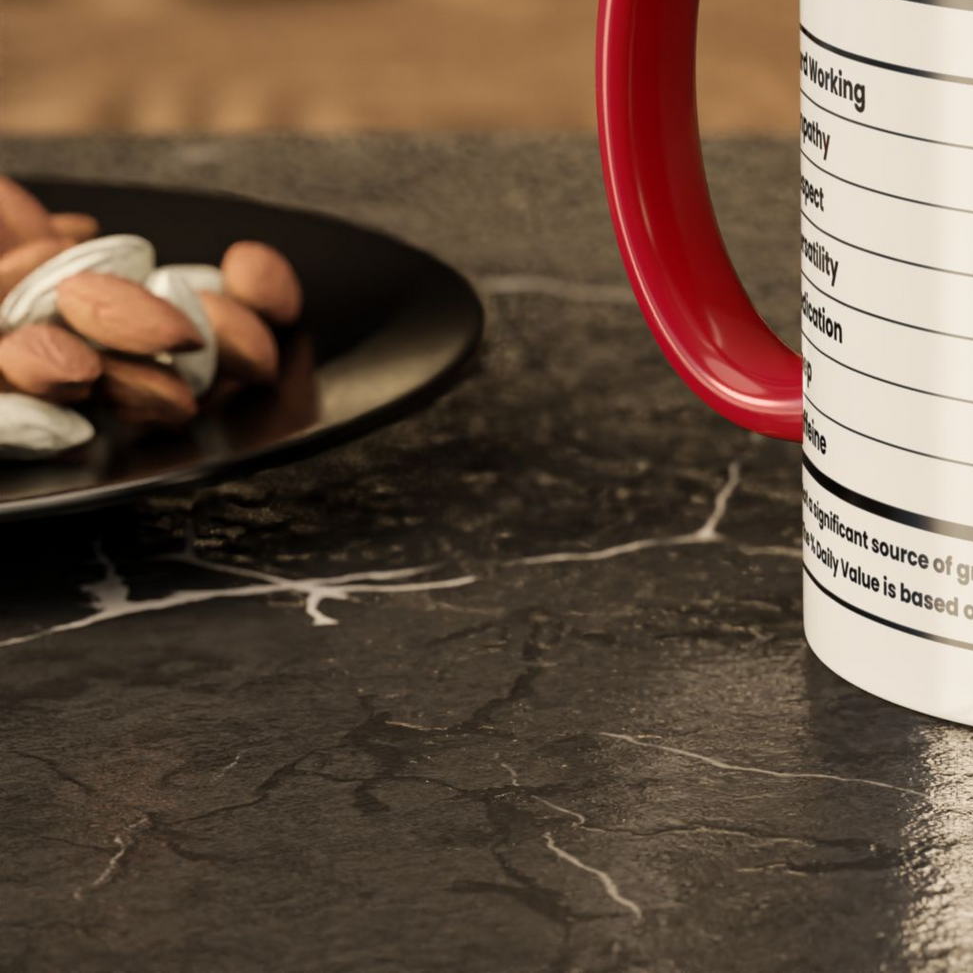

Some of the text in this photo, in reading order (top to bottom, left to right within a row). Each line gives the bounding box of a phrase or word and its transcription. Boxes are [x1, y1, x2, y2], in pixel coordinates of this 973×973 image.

[809, 55, 866, 114] Working
[800, 113, 830, 161] pathy
[801, 175, 825, 212] spect
[801, 233, 839, 287] rsatility
[801, 291, 843, 344] dication
[803, 409, 827, 455] ffeine
[813, 500, 869, 550] significant
[871, 537, 929, 569] source
[933, 555, 952, 576] of
[816, 540, 839, 578] Daily
[840, 557, 880, 592] Value
[883, 576, 897, 599] is
[900, 582, 959, 617] based
